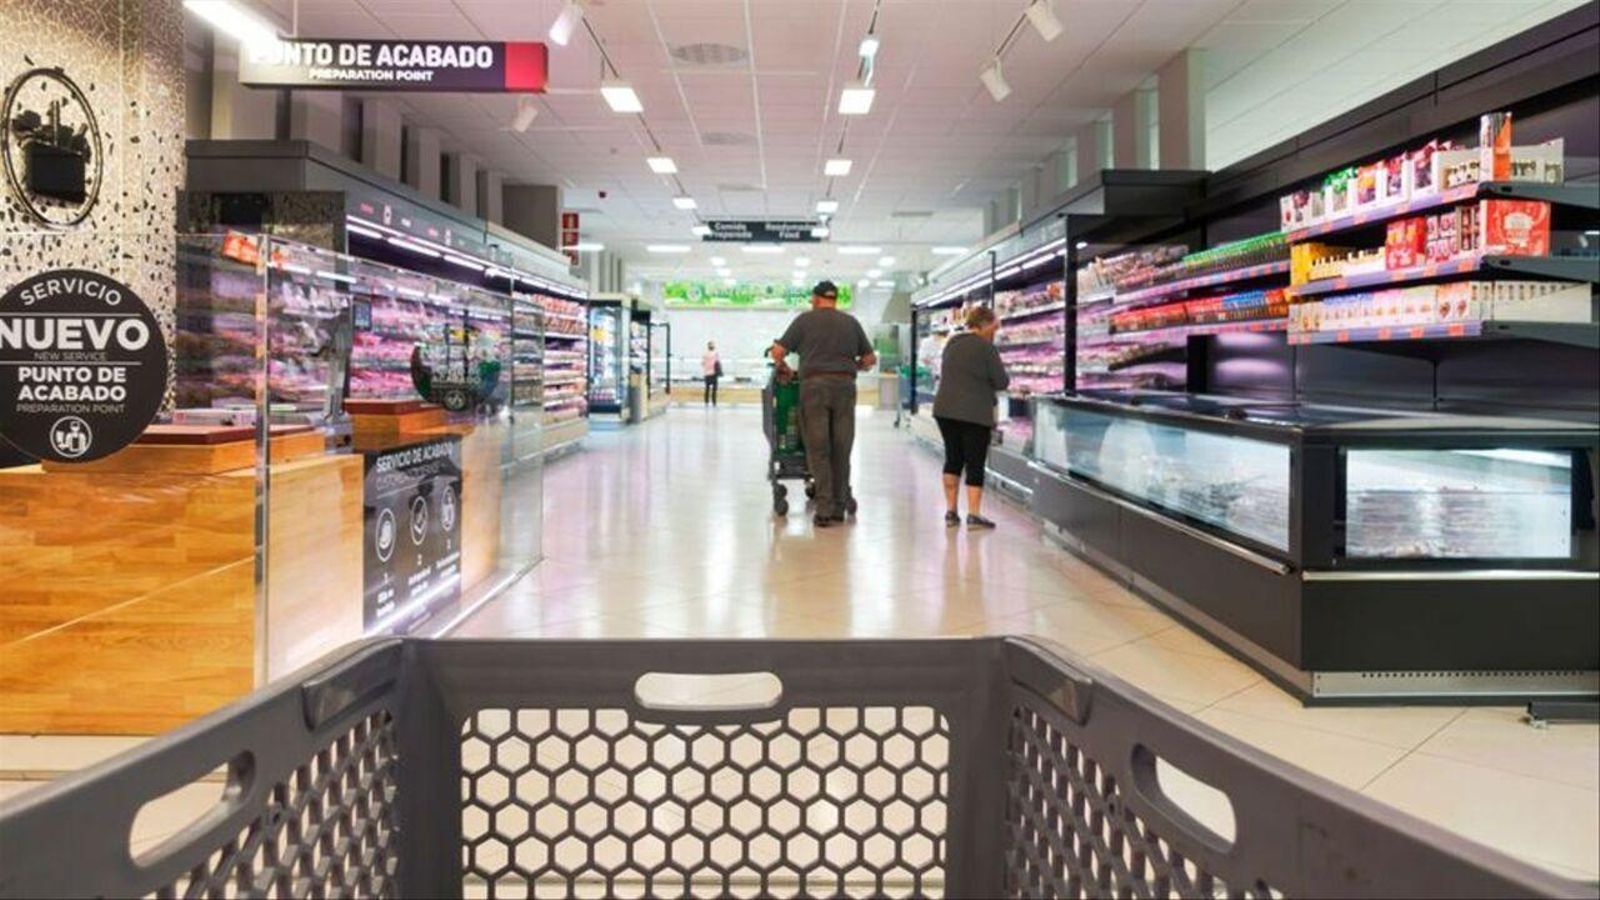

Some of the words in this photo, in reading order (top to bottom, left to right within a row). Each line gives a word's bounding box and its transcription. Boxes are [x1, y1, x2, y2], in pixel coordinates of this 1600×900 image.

[339, 43, 372, 67] DE
[376, 44, 494, 68] ACABADO
[308, 69, 394, 81] PREPARATION
[396, 70, 434, 82] POINT
[20, 278, 121, 305] SERVICIO
[0, 318, 149, 350] NUEVO
[34, 352, 59, 360] NEW
[62, 352, 106, 361] SERVICE
[18, 367, 92, 382] PUNTO
[97, 367, 127, 383] DE
[18, 385, 126, 401] ACABADO
[16, 403, 91, 413] PREPARATION
[94, 403, 125, 413] POINT
